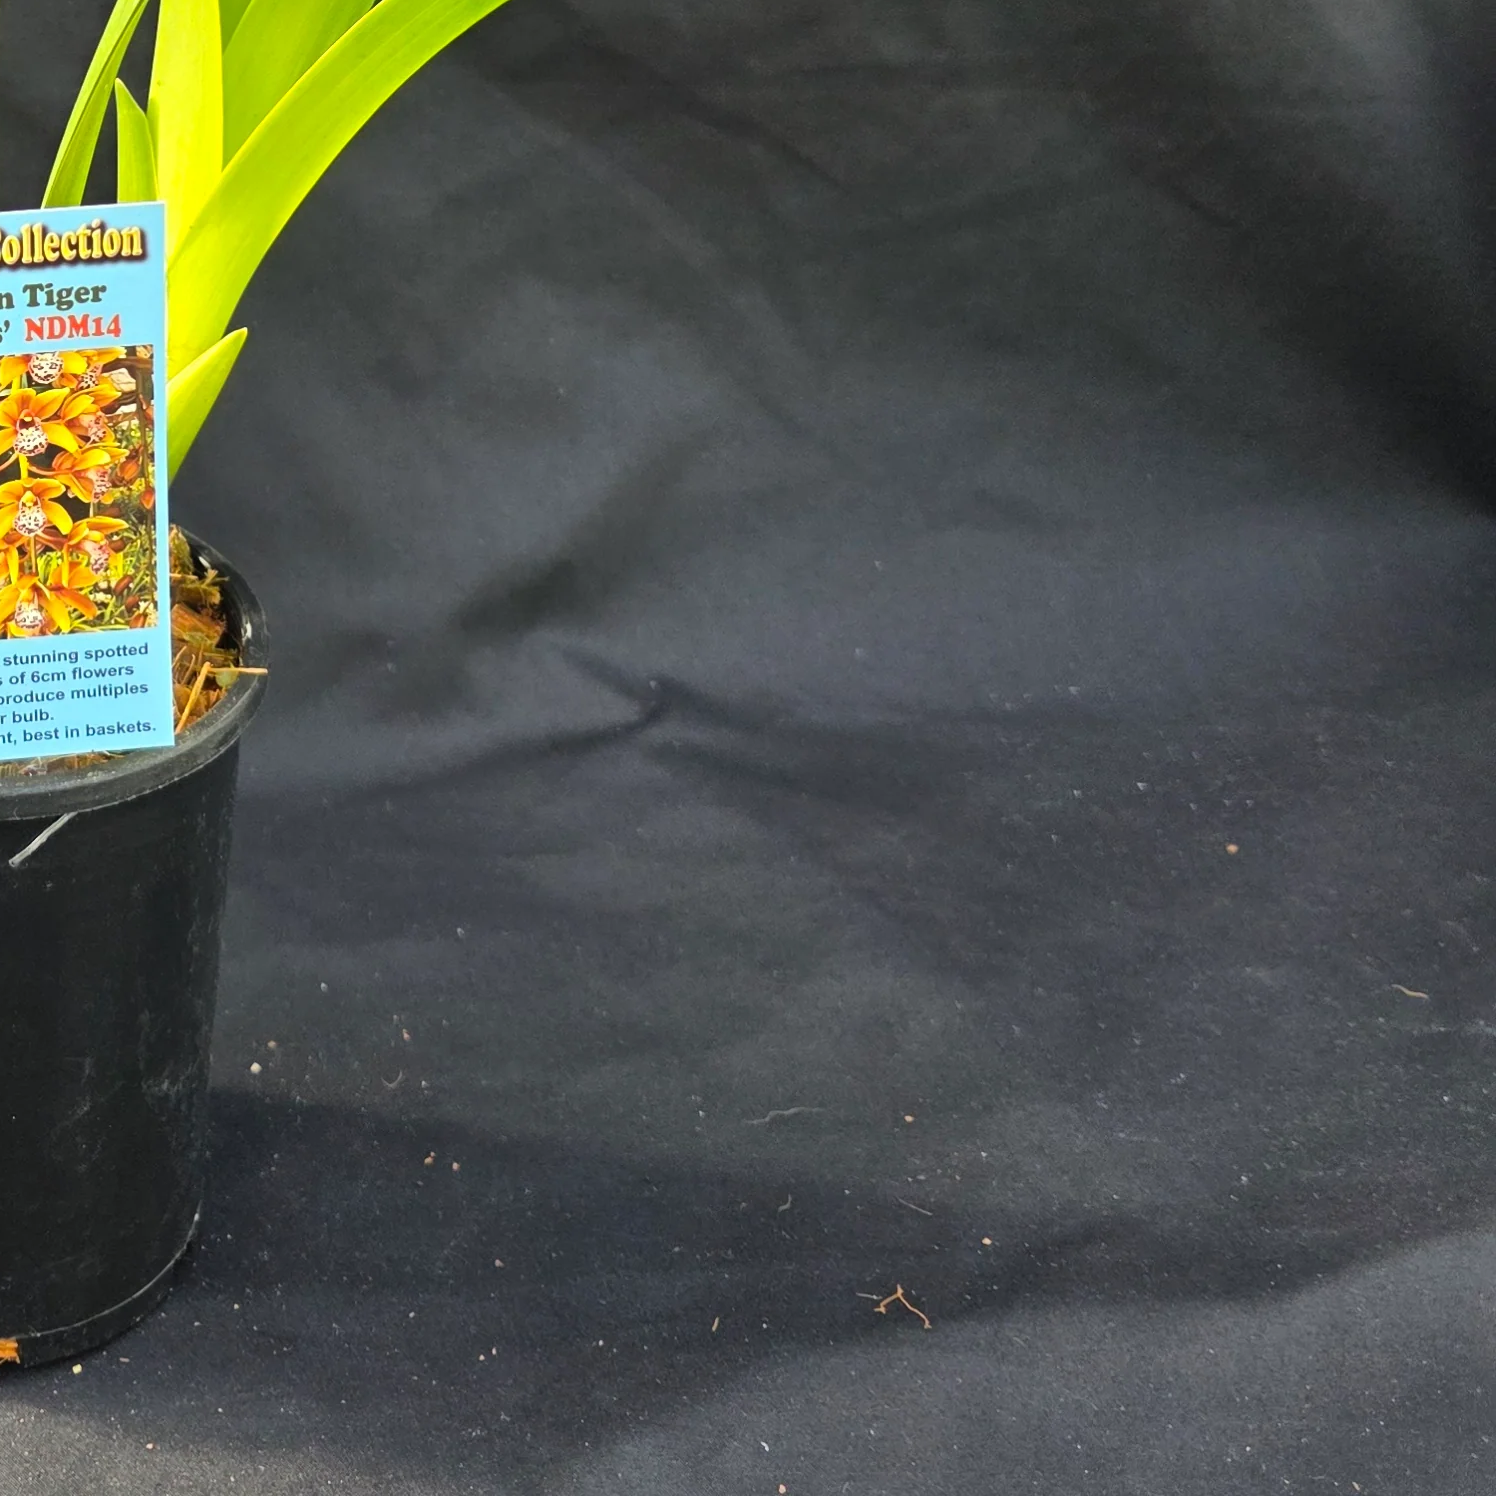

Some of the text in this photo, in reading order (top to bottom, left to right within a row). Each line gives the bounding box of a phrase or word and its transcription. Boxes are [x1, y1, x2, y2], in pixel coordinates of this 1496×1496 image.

[23, 282, 107, 311] Tiger
[25, 313, 121, 342] NDM14
[3, 648, 79, 666] stunning
[84, 643, 149, 661] spotted
[9, 672, 26, 685] of
[31, 670, 66, 683] 6cm
[72, 664, 133, 681] flowers
[71, 682, 149, 700] multiples
[12, 709, 53, 723] bulb.
[22, 727, 59, 742] best
[65, 725, 80, 738] in
[86, 721, 156, 736] baskets.
